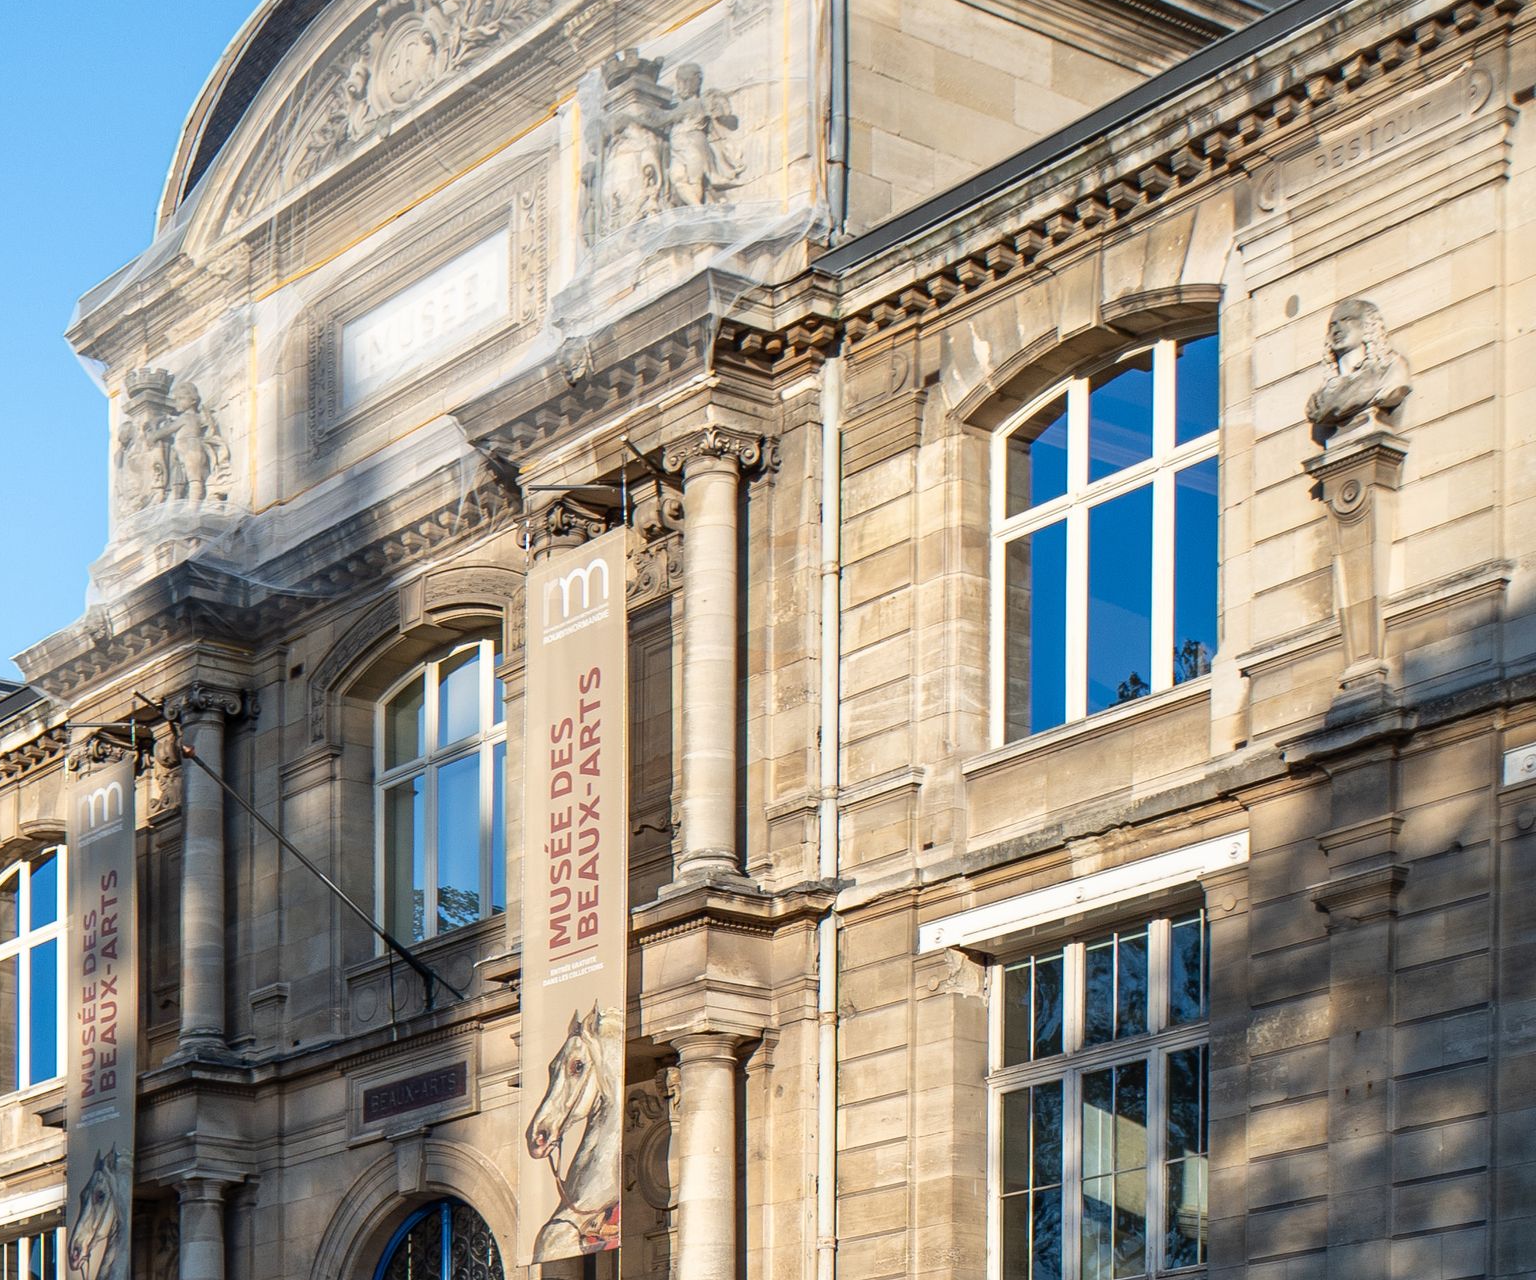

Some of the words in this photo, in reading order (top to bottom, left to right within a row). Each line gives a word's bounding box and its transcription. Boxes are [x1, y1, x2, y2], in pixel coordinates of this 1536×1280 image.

[550, 717, 573, 800] DES
[577, 666, 601, 940] BEAUX-ARTS
[544, 805, 573, 949] MUSÉE
[83, 909, 97, 976] DES
[99, 869, 118, 1093] BEAUX-ARTS
[77, 981, 96, 1099] MUSÉE
[369, 1072, 456, 1113] BEAUX-ARTS
